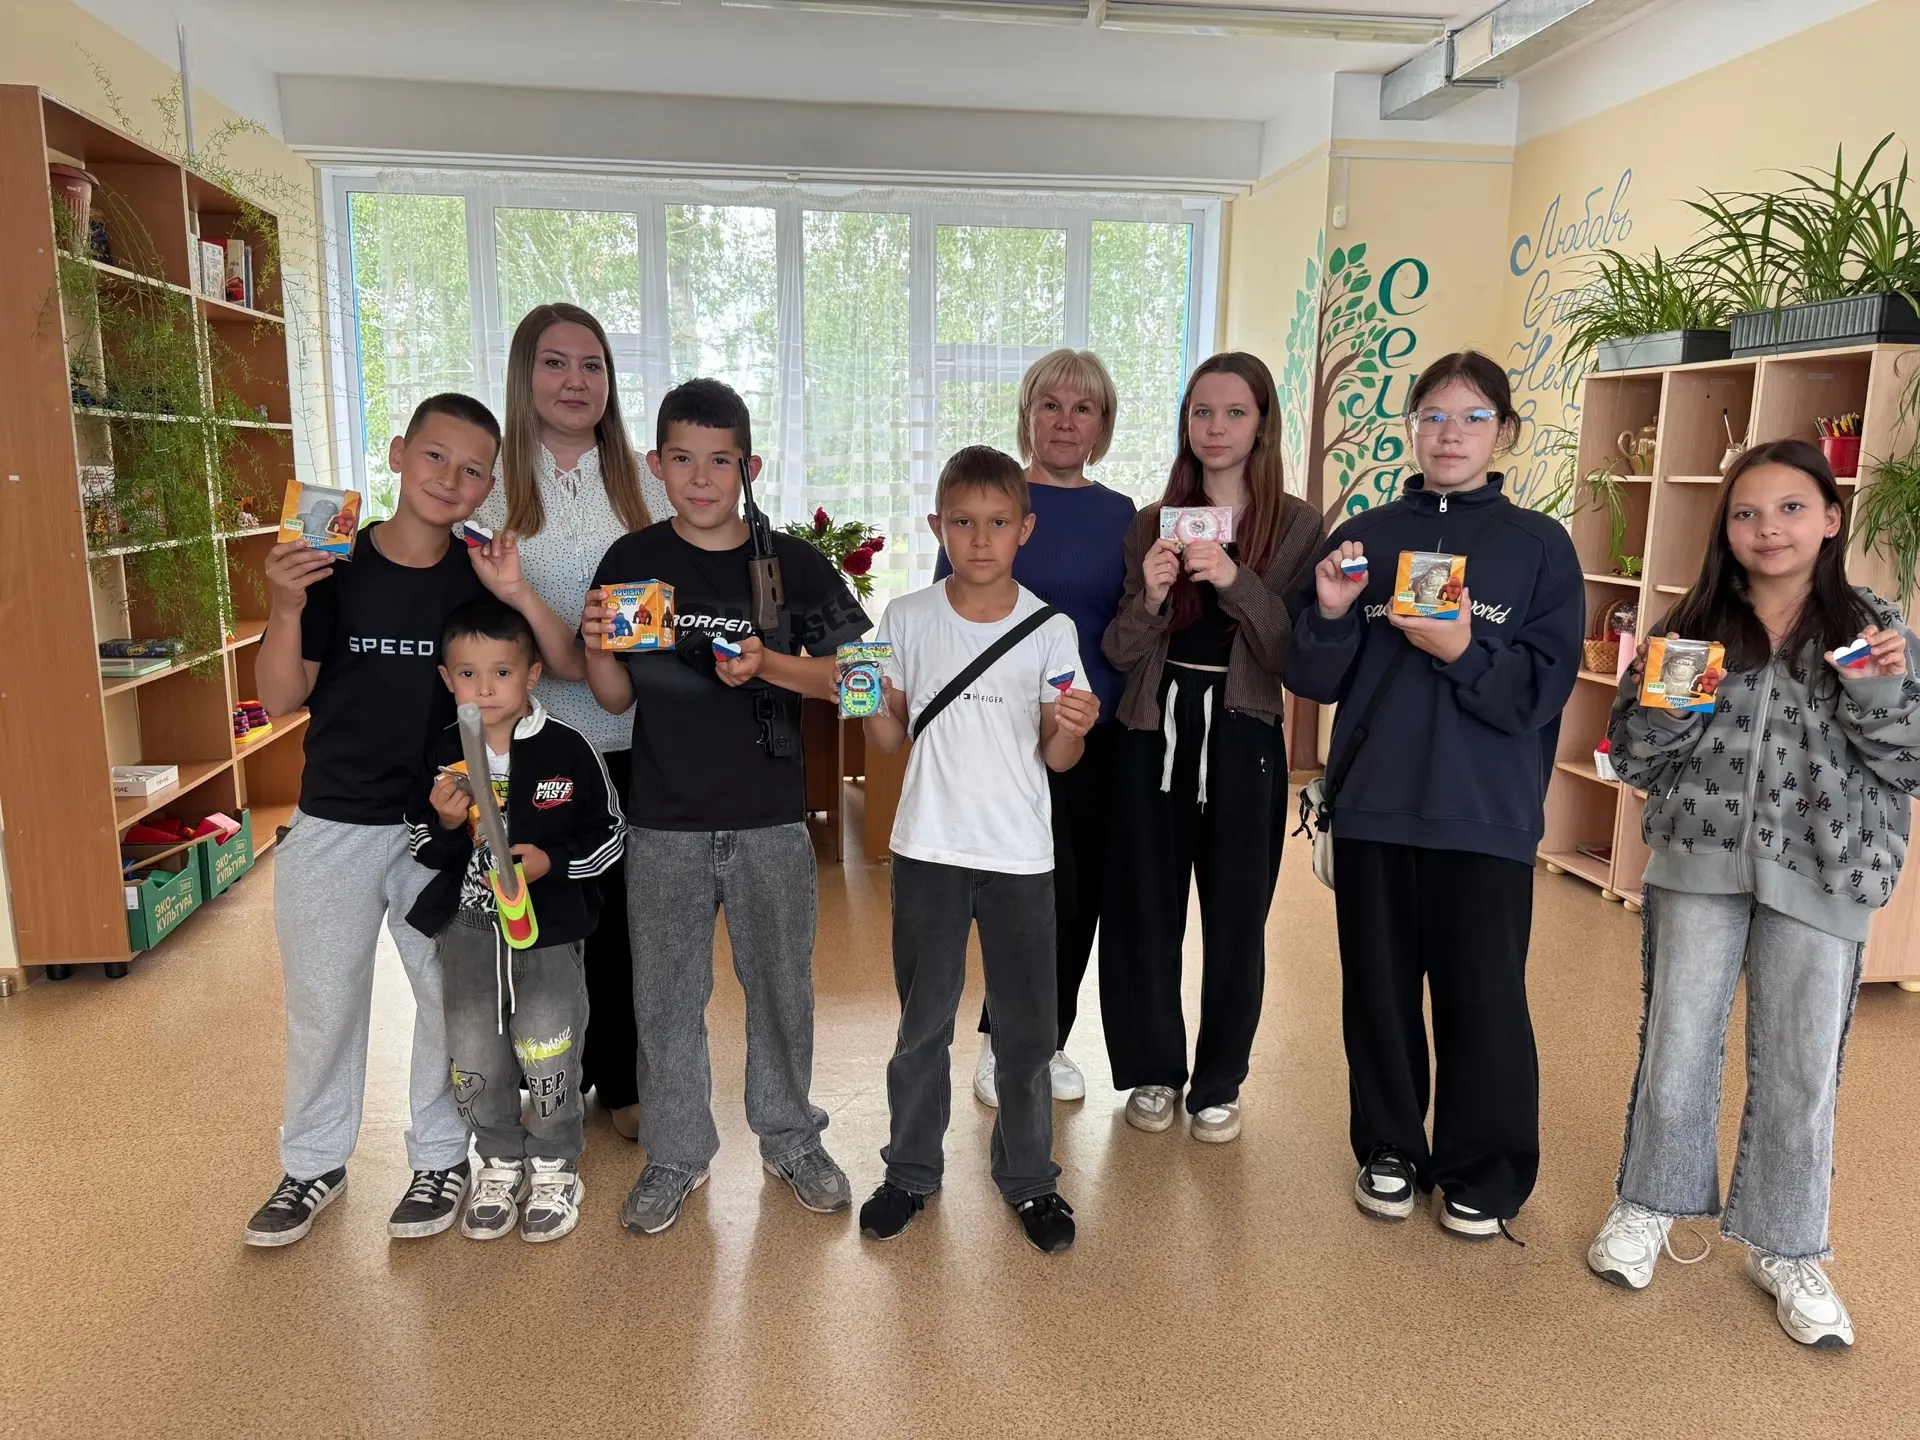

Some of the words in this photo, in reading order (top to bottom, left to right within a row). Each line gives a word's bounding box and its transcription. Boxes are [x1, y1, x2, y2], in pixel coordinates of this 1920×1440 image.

[1509, 168, 1633, 276] Любовь
[612, 588, 645, 597] SQUISHY
[621, 597, 638, 606] TOY
[674, 614, 757, 634] ORFEN
[349, 636, 434, 656] SPEED
[972, 693, 1004, 704] HIFIGER
[535, 790, 570, 800] FAST
[536, 781, 574, 791] MOVE
[215, 853, 233, 872] ЭКО-
[216, 854, 247, 886] КУЛЬТУРА
[154, 895, 176, 918] ЭКО-
[156, 894, 193, 934] КУЛЬТУРА
[526, 1069, 566, 1098] EEP
[540, 1087, 568, 1120] LM
